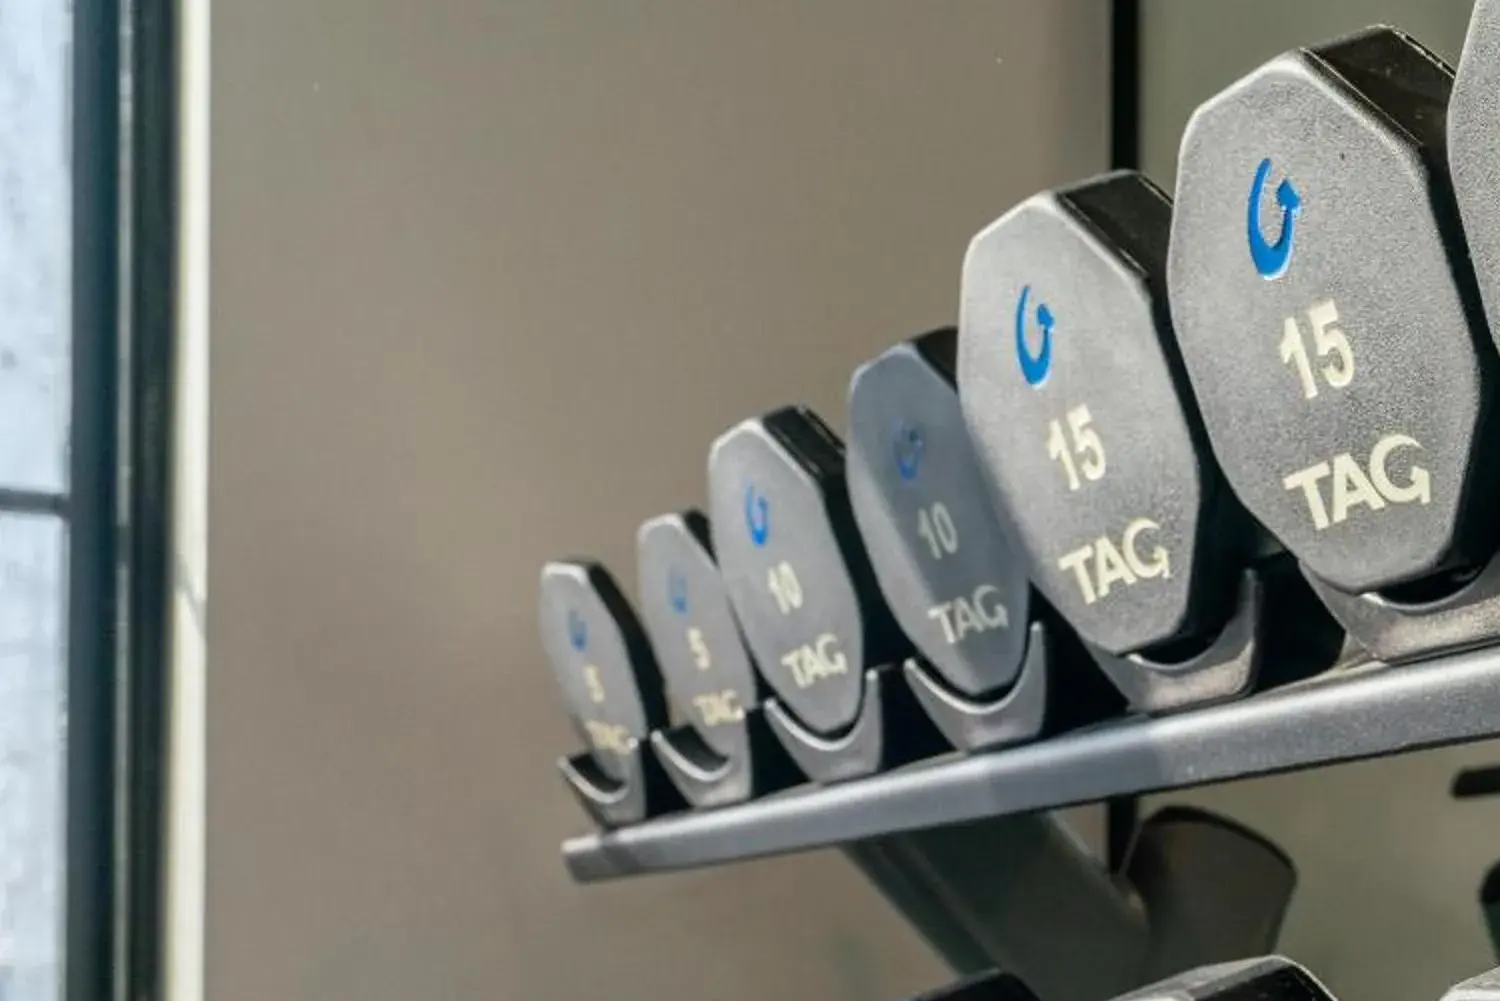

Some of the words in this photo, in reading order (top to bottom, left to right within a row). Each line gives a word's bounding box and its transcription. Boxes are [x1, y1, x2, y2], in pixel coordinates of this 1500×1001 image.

[1279, 298, 1355, 399] 15
[1046, 403, 1107, 492] 15
[1284, 433, 1430, 530] TAG
[916, 500, 959, 561] 10
[1058, 516, 1170, 605] TAG
[927, 583, 1008, 644] TAG
[780, 633, 848, 688] TAG
